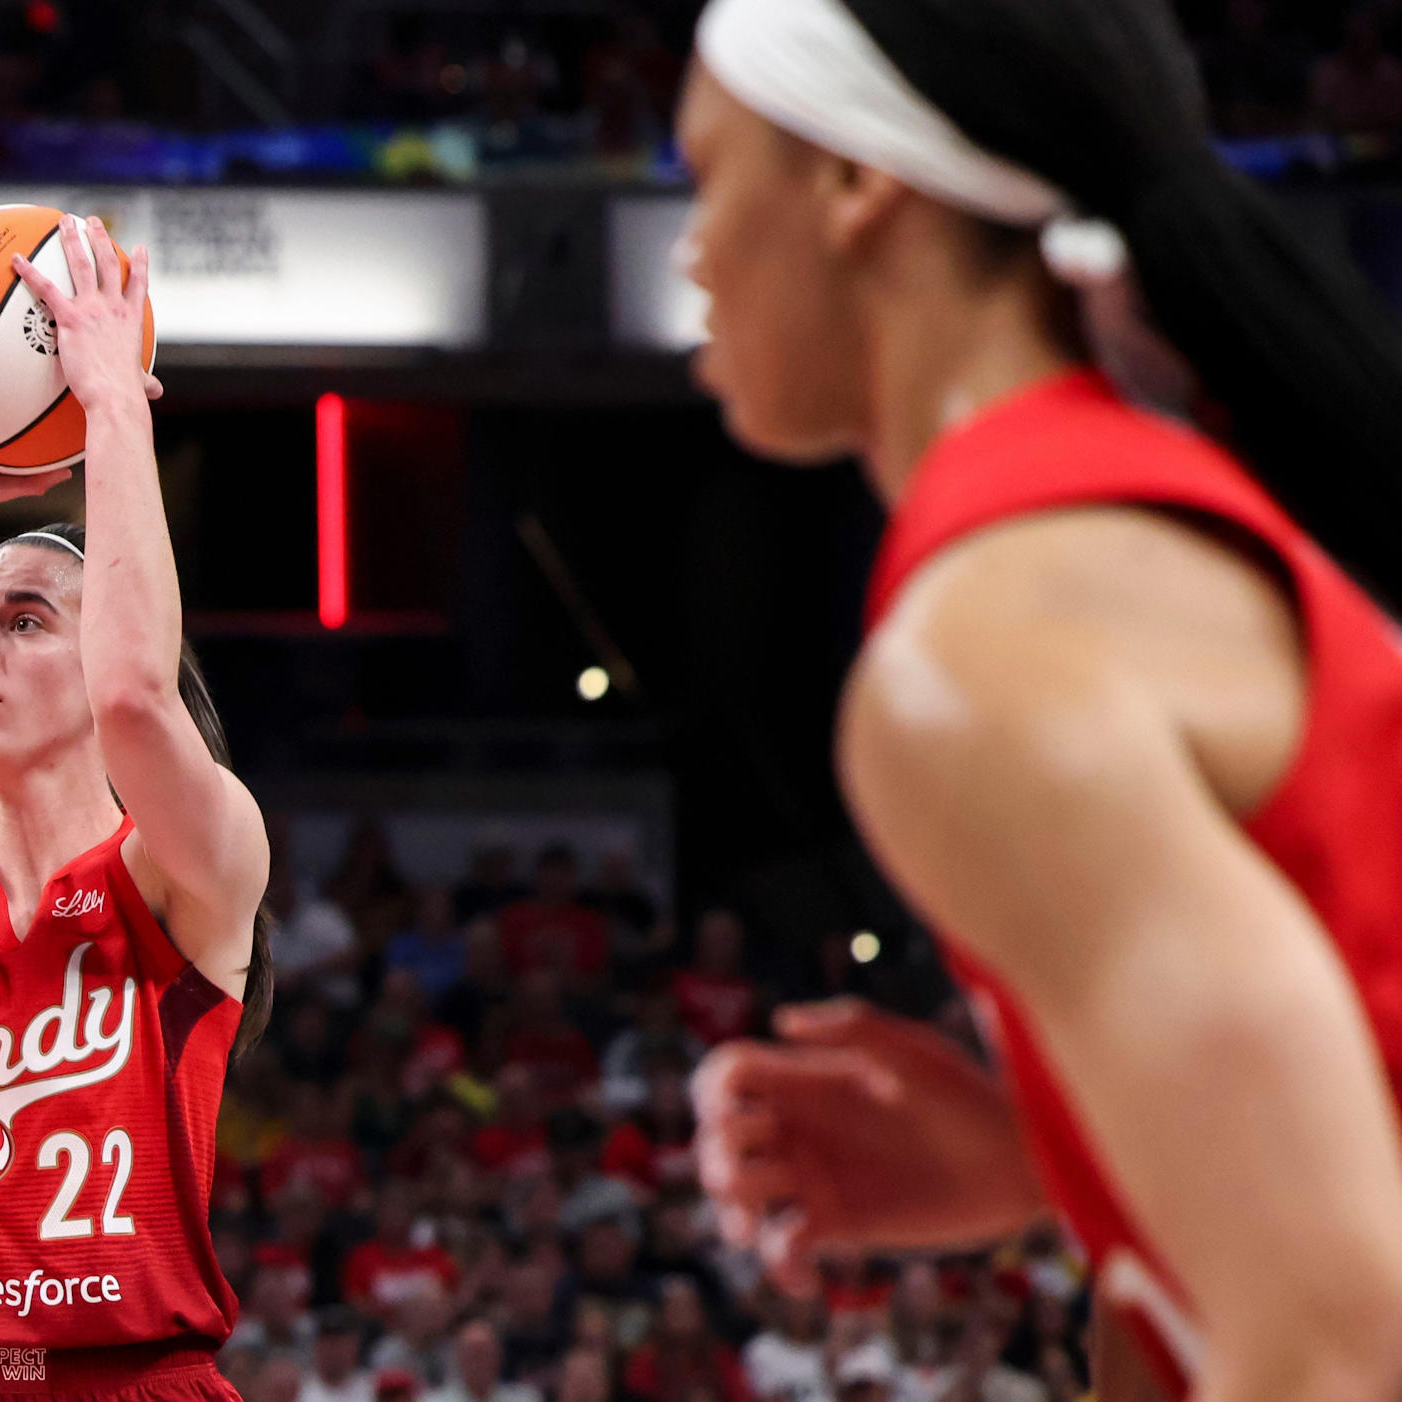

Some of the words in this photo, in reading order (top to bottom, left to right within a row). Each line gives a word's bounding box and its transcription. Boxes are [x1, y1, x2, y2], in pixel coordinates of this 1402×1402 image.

[52, 889, 105, 918] Lilly
[36, 1128, 137, 1240] 22
[2, 1364, 47, 1382] WIN
